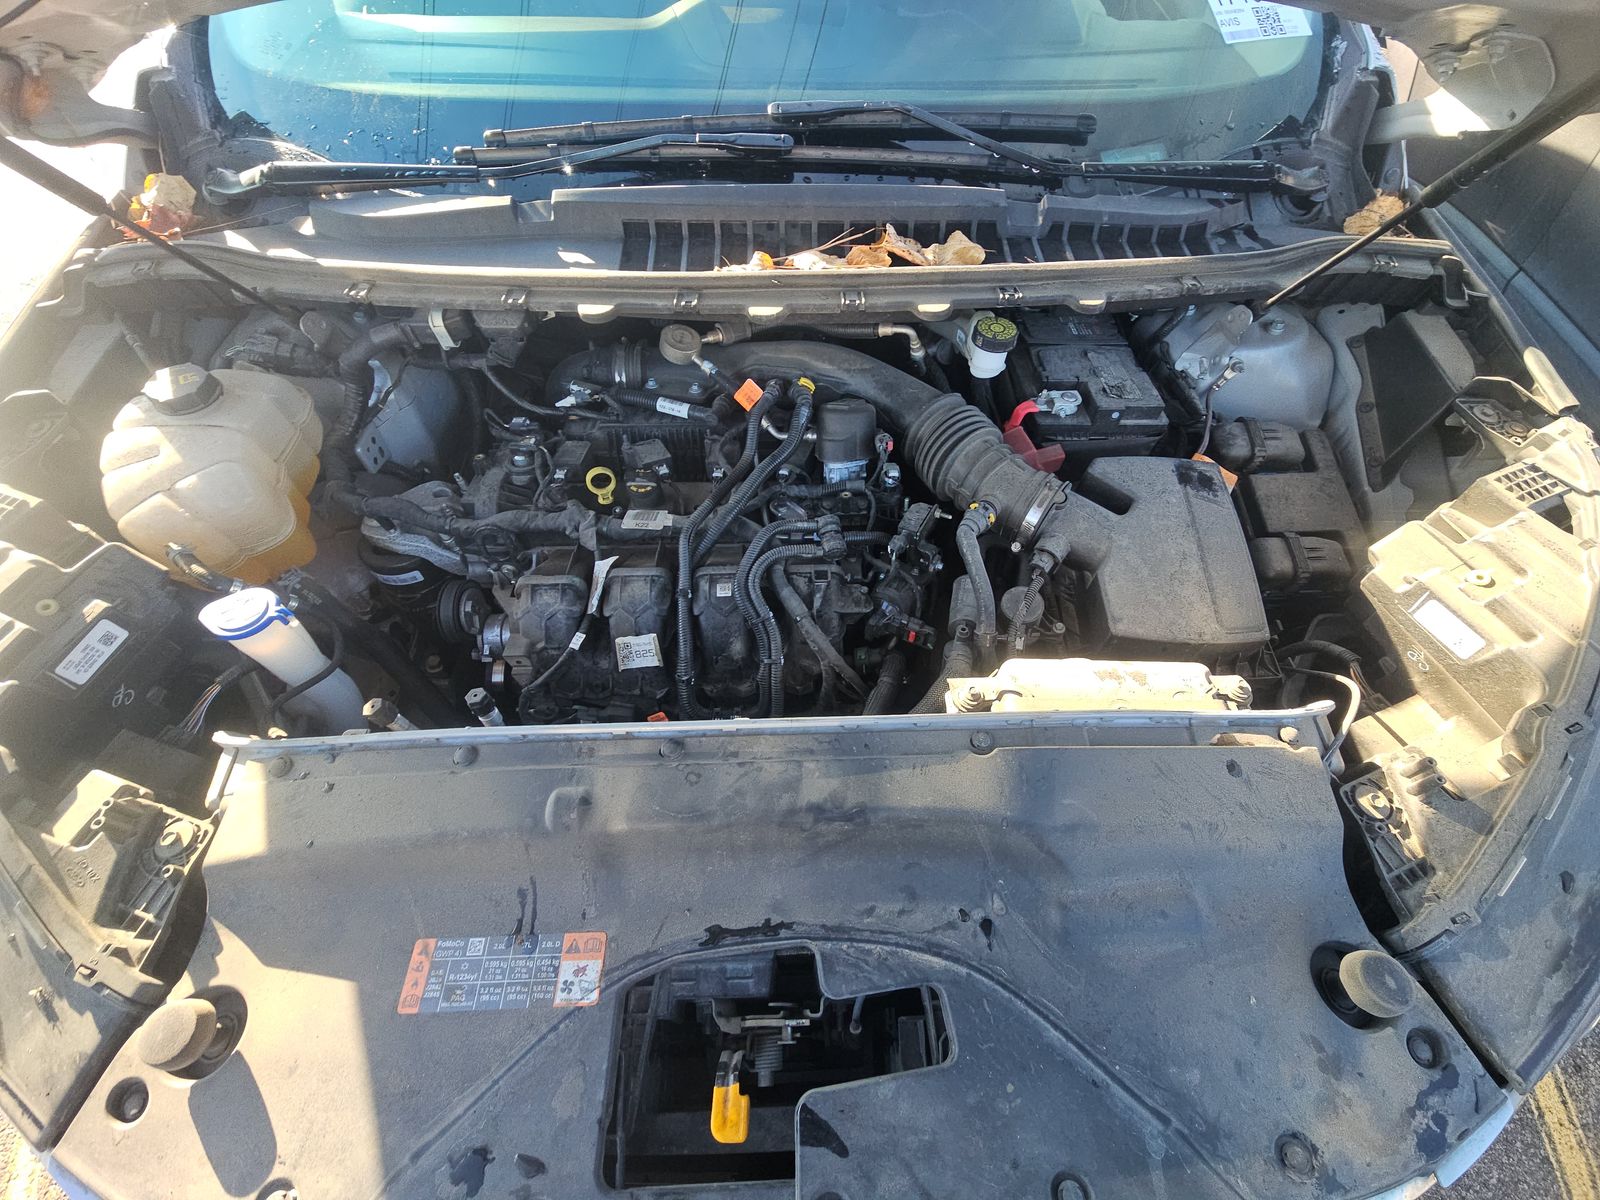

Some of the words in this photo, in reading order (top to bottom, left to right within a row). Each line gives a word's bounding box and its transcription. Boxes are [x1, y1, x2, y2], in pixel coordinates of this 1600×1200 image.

[1220, 17, 1240, 27] AVIS
[635, 649, 654, 658] 825
[449, 973, 477, 981] R-1234yf
